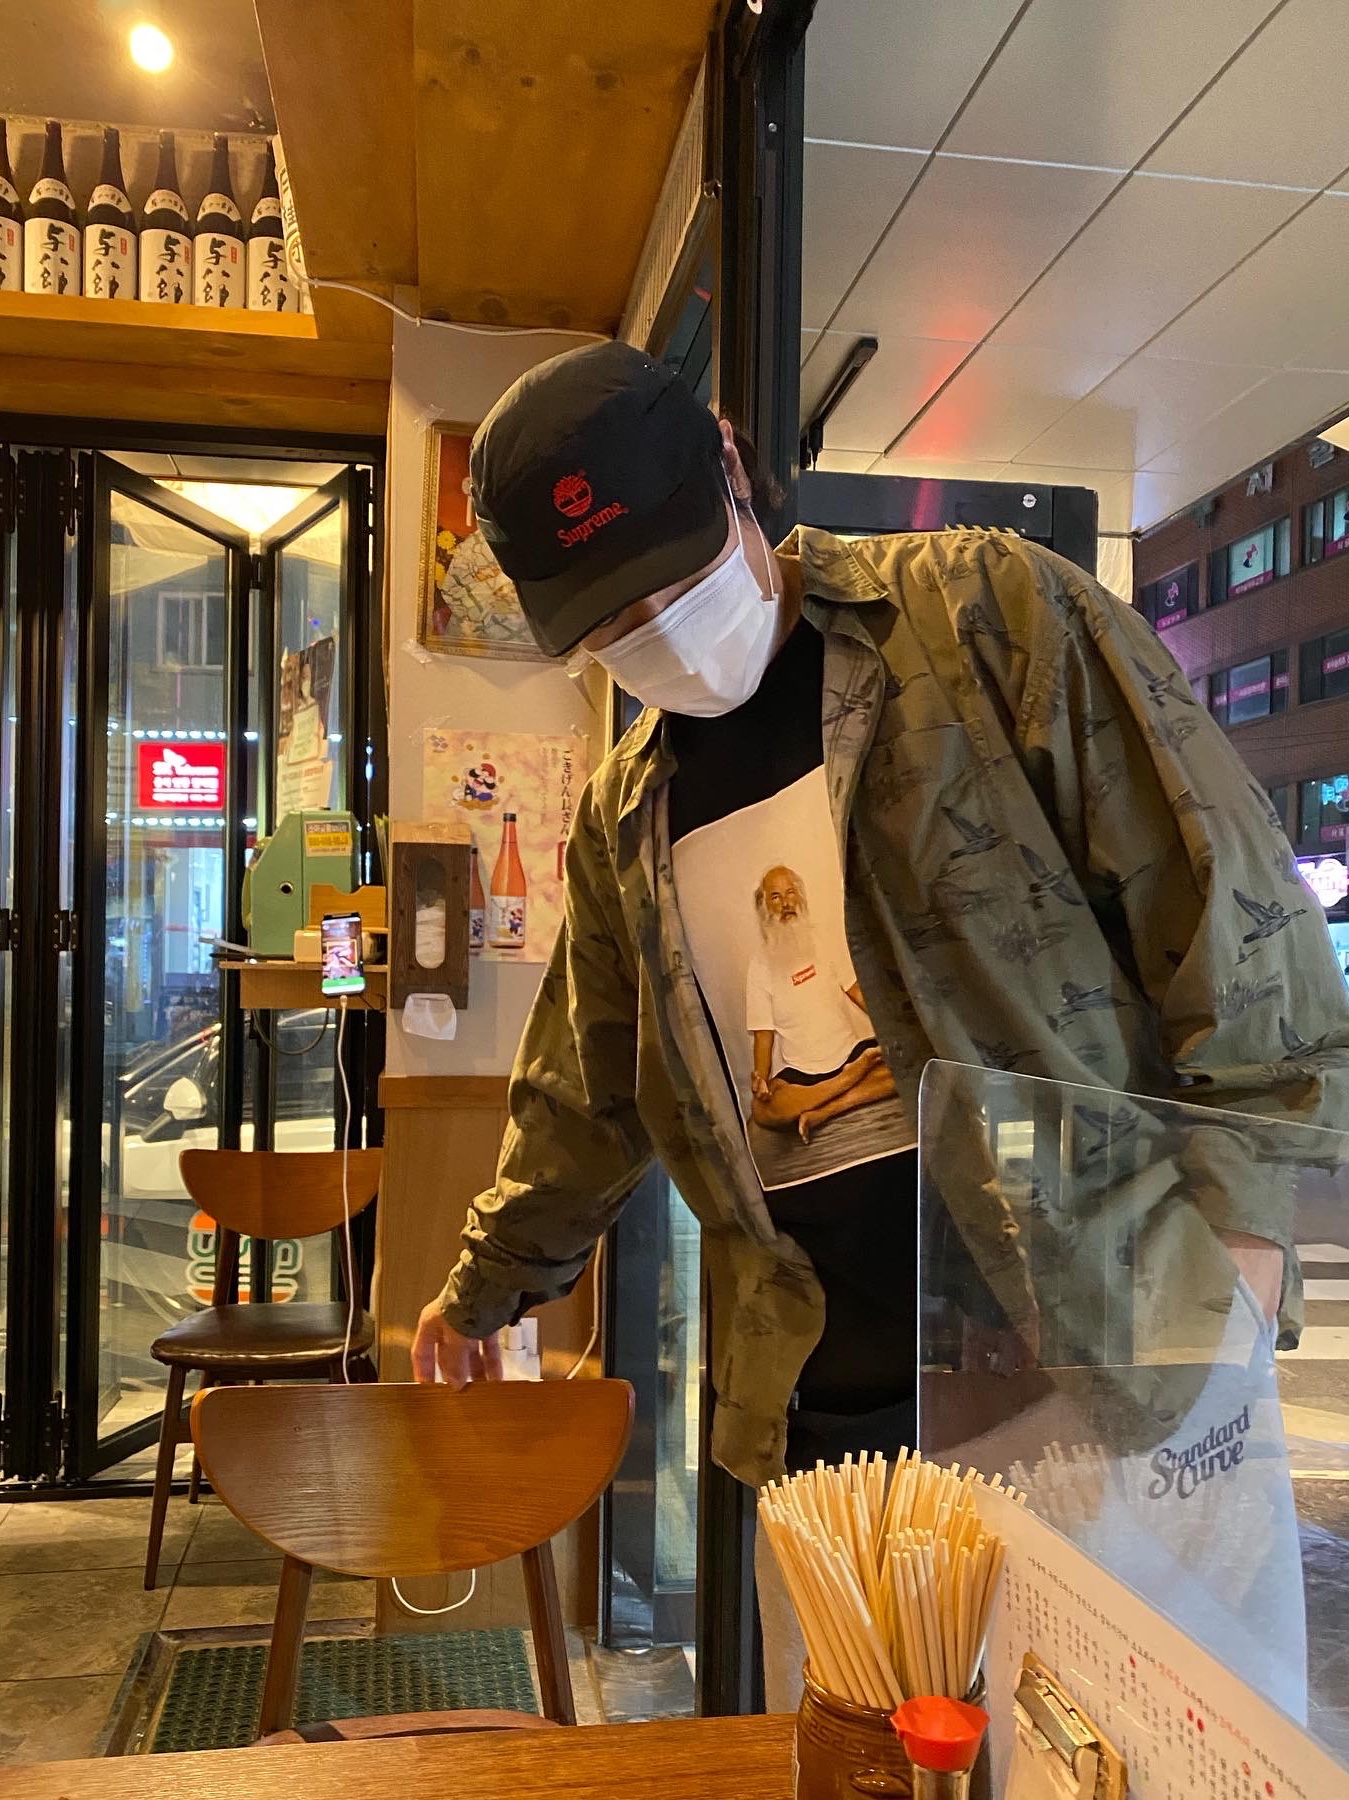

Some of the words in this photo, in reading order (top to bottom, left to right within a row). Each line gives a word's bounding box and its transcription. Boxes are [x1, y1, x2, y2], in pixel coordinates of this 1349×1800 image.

[556, 502, 623, 548] Supreme
[1148, 1404, 1251, 1499] Standard
[1177, 1440, 1244, 1499] Curve
